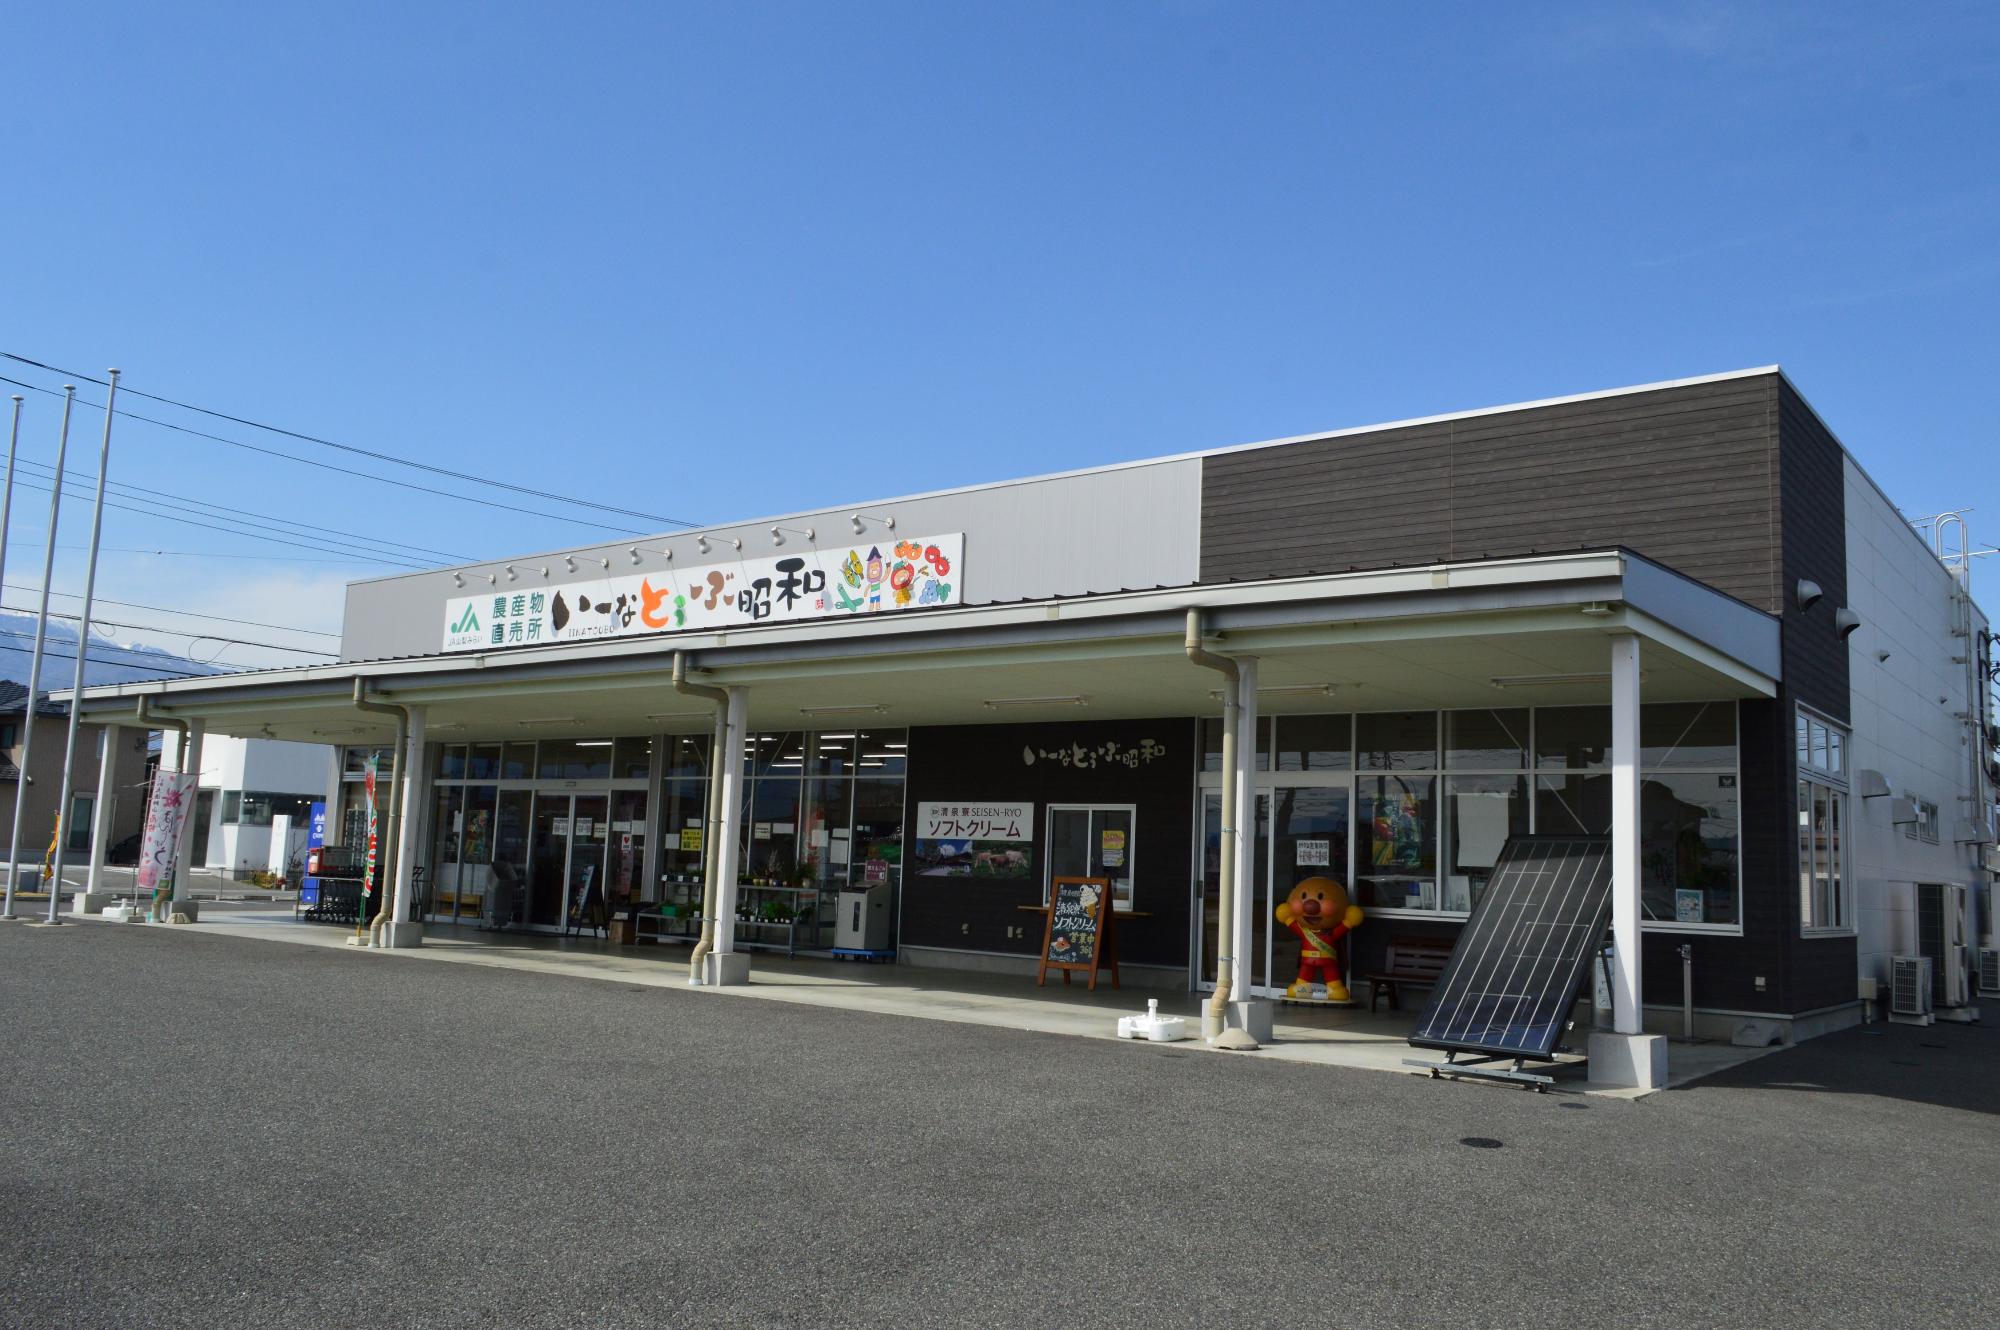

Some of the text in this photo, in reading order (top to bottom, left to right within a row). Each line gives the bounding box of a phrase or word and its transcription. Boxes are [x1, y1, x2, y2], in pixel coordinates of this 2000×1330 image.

[493, 592, 545, 618] 農産物
[491, 618, 542, 644] 直売所
[971, 808, 1022, 817] SEISEN-RYO
[929, 820, 1020, 837] ソフトクリーム
[1054, 916, 1096, 931] ソフトクリーム
